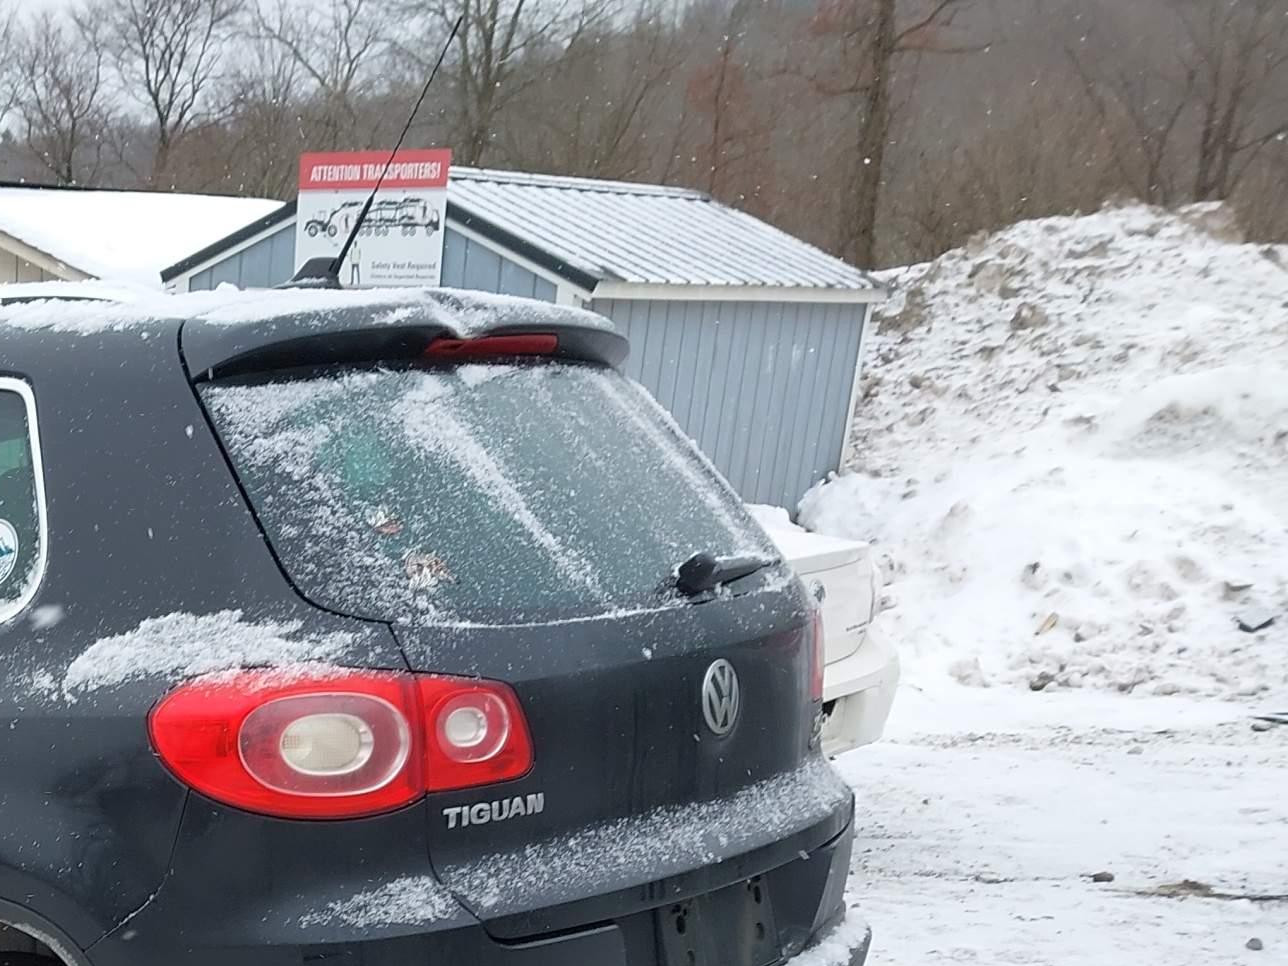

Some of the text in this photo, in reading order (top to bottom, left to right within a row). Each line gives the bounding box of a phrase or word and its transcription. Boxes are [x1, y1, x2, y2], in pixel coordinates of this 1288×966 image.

[311, 162, 441, 182] ATTENTION TRANSPORTERS!
[443, 793, 544, 829] TIGUAN
